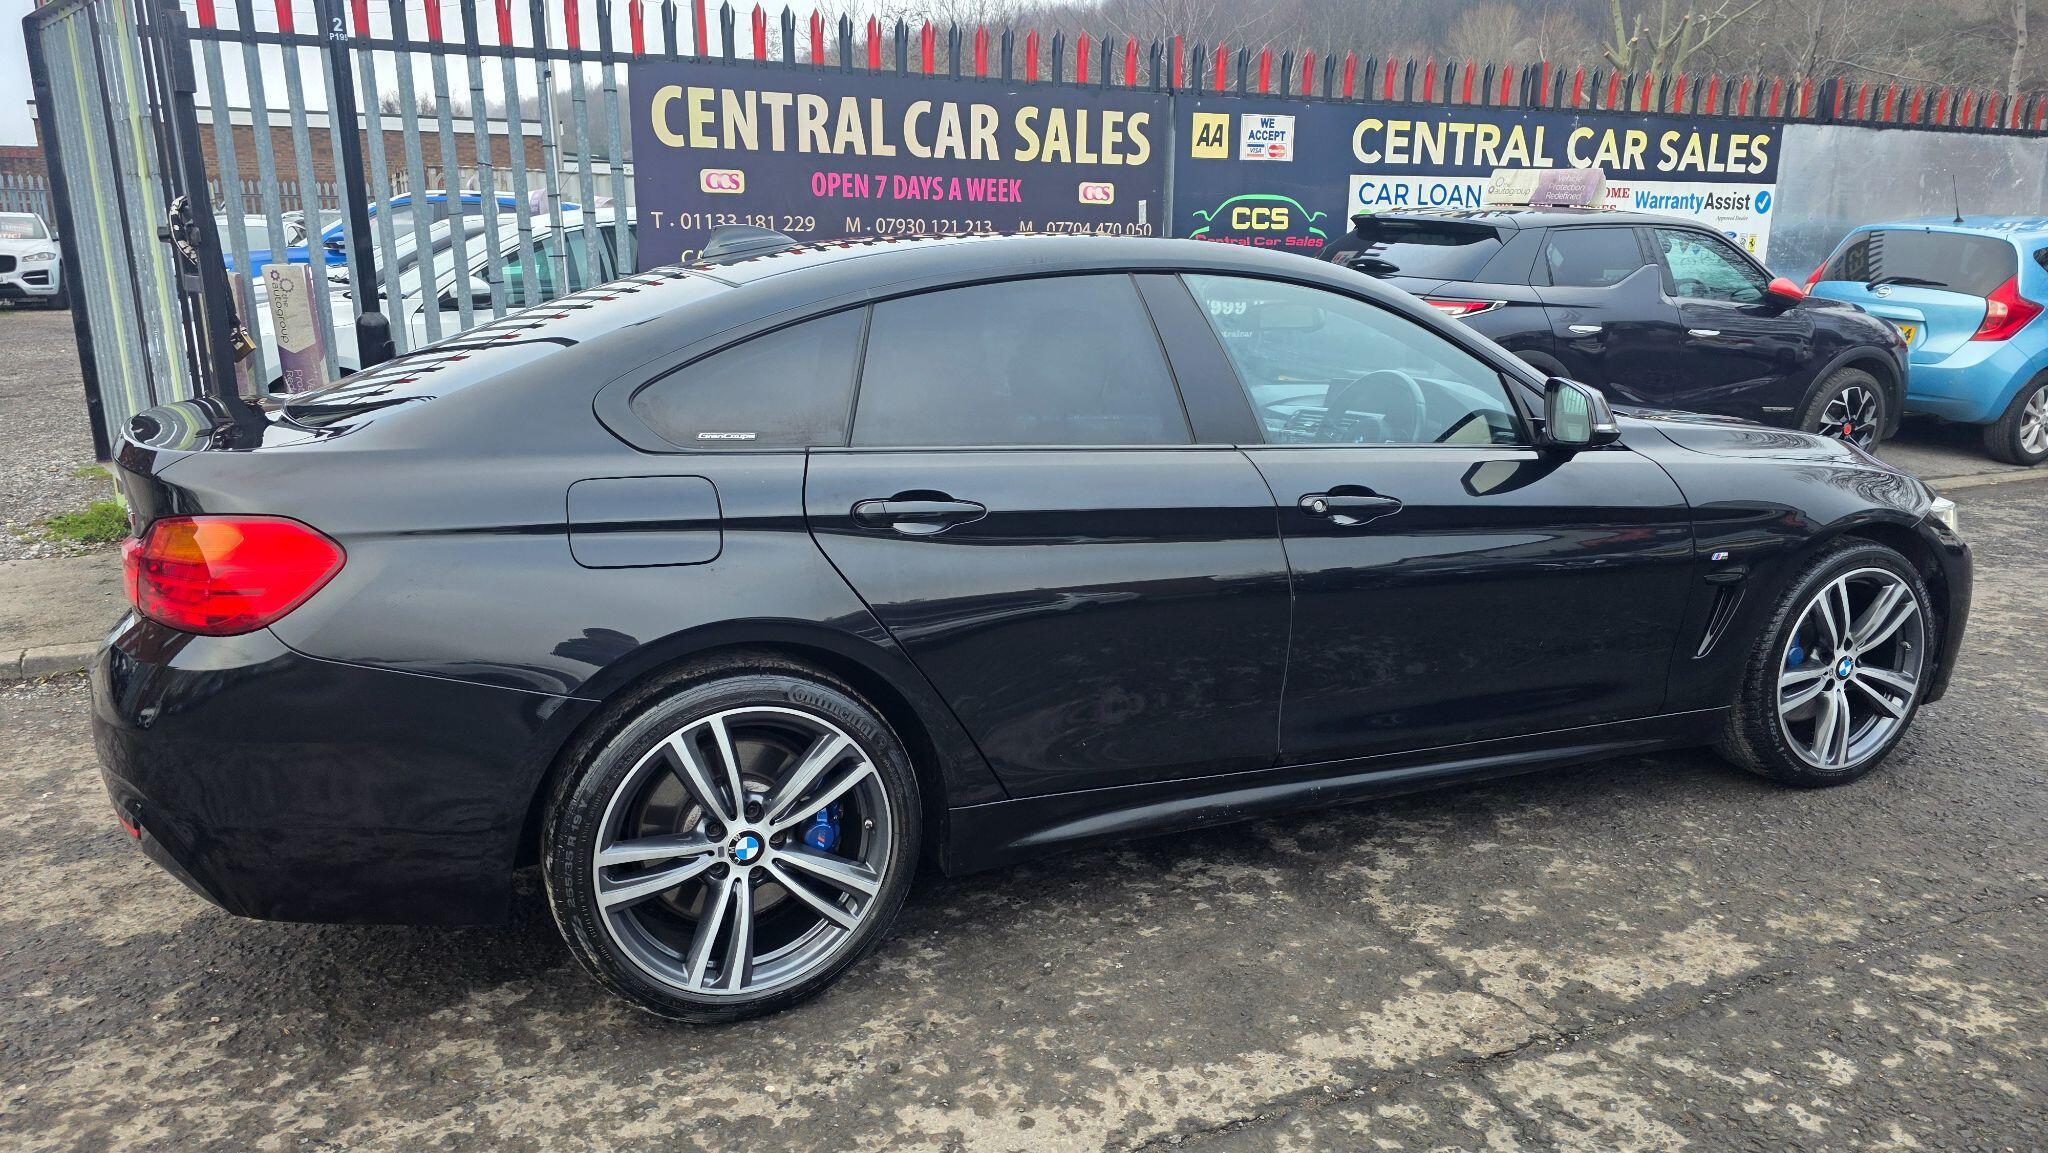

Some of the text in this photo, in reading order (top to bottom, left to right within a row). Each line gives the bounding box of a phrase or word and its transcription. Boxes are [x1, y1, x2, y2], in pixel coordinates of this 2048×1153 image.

[332, 17, 343, 32] 2
[651, 85, 1150, 166] CENTRAL CAR SALES
[1260, 118, 1275, 128] WE
[1196, 123, 1224, 147] AA
[1248, 130, 1286, 141] ACCEPT
[1352, 118, 1770, 175] CENTRAL CAR SALES
[1548, 182, 1586, 191] Protection
[1558, 174, 1583, 182] Vehicle
[811, 172, 1022, 203] OPEN 7 DAYS A WEEK
[1358, 182, 1482, 208] CAR LOAN
[1493, 187, 1531, 196] autogroup
[1545, 191, 1582, 200] Redefined
[680, 213, 737, 230] 01133
[745, 214, 775, 231] 181
[783, 215, 816, 232] 229
[875, 217, 926, 235] 07930
[931, 218, 958, 234] 121
[965, 219, 992, 233] 213
[1232, 207, 1289, 230] CCS
[1254, 236, 1282, 246] Car
[1285, 236, 1324, 247] Sales
[272, 282, 289, 343] autogroup
